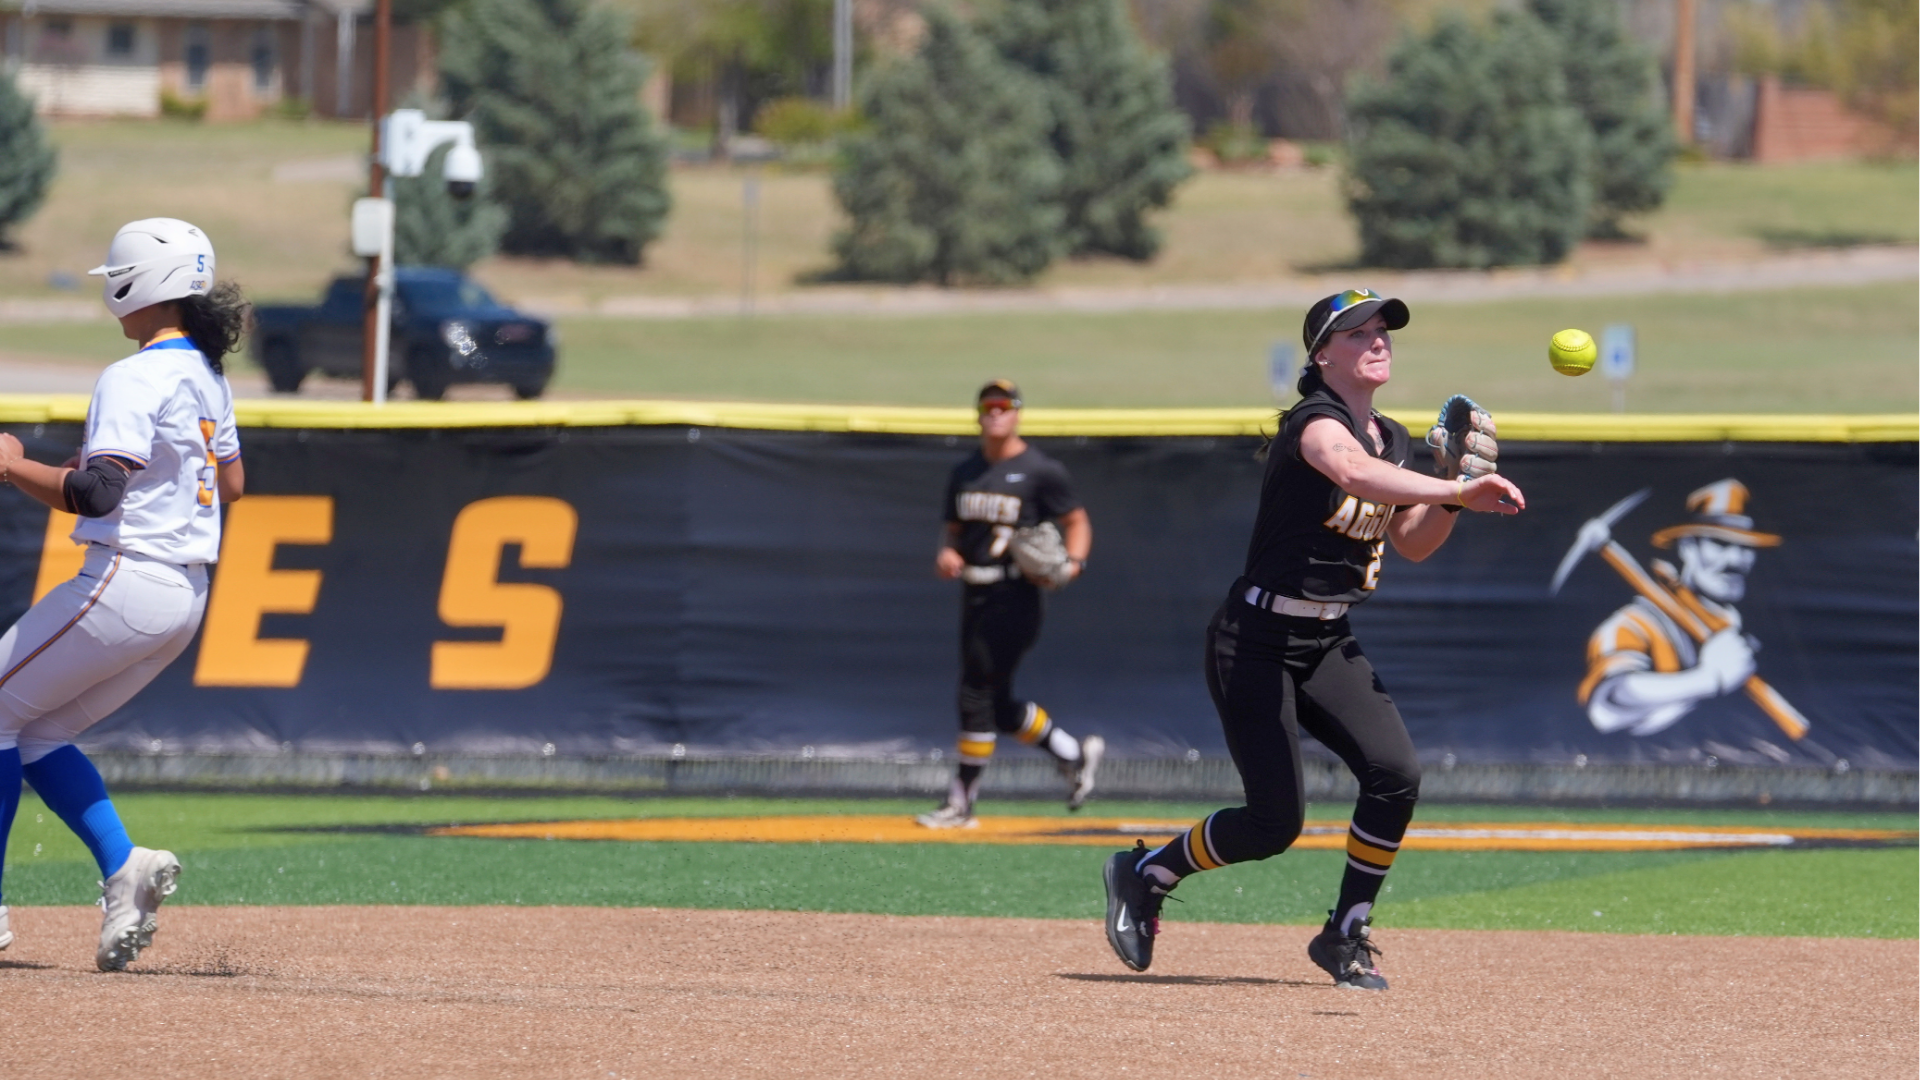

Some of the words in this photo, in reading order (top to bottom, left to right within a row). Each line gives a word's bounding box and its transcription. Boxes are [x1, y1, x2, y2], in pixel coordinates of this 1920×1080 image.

[196, 254, 205, 273] 5
[196, 416, 219, 509] 5
[990, 524, 1014, 558] 7
